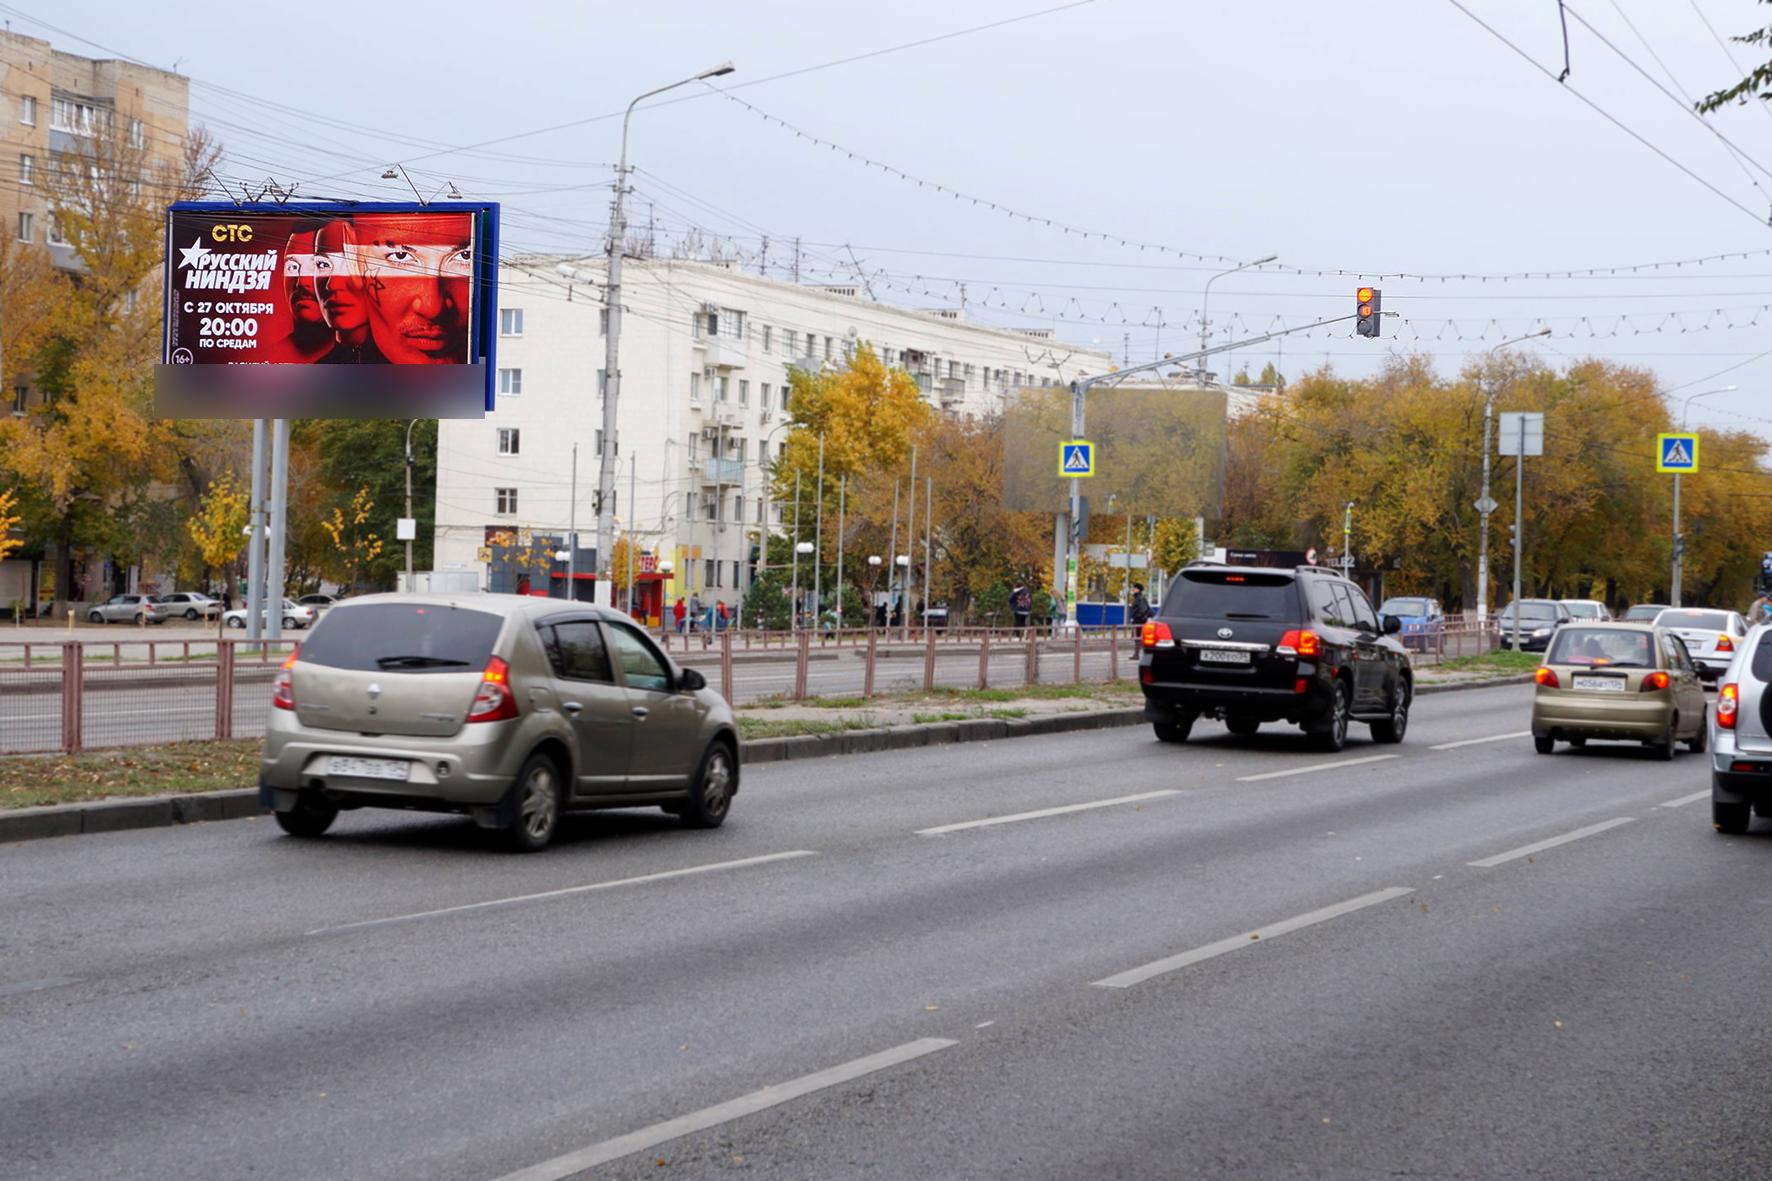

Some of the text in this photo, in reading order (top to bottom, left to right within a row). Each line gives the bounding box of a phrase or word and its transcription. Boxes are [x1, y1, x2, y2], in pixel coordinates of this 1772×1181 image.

[212, 224, 253, 242] СТС
[198, 249, 278, 270] РУССКИЙ
[185, 270, 272, 293] НИНДЗЯ
[184, 302, 274, 314] С 27 ОКТЯБРЯ
[200, 318, 258, 336] 20:00
[199, 339, 257, 349] ПО СРЕДАМ
[174, 354, 190, 364] 16+
